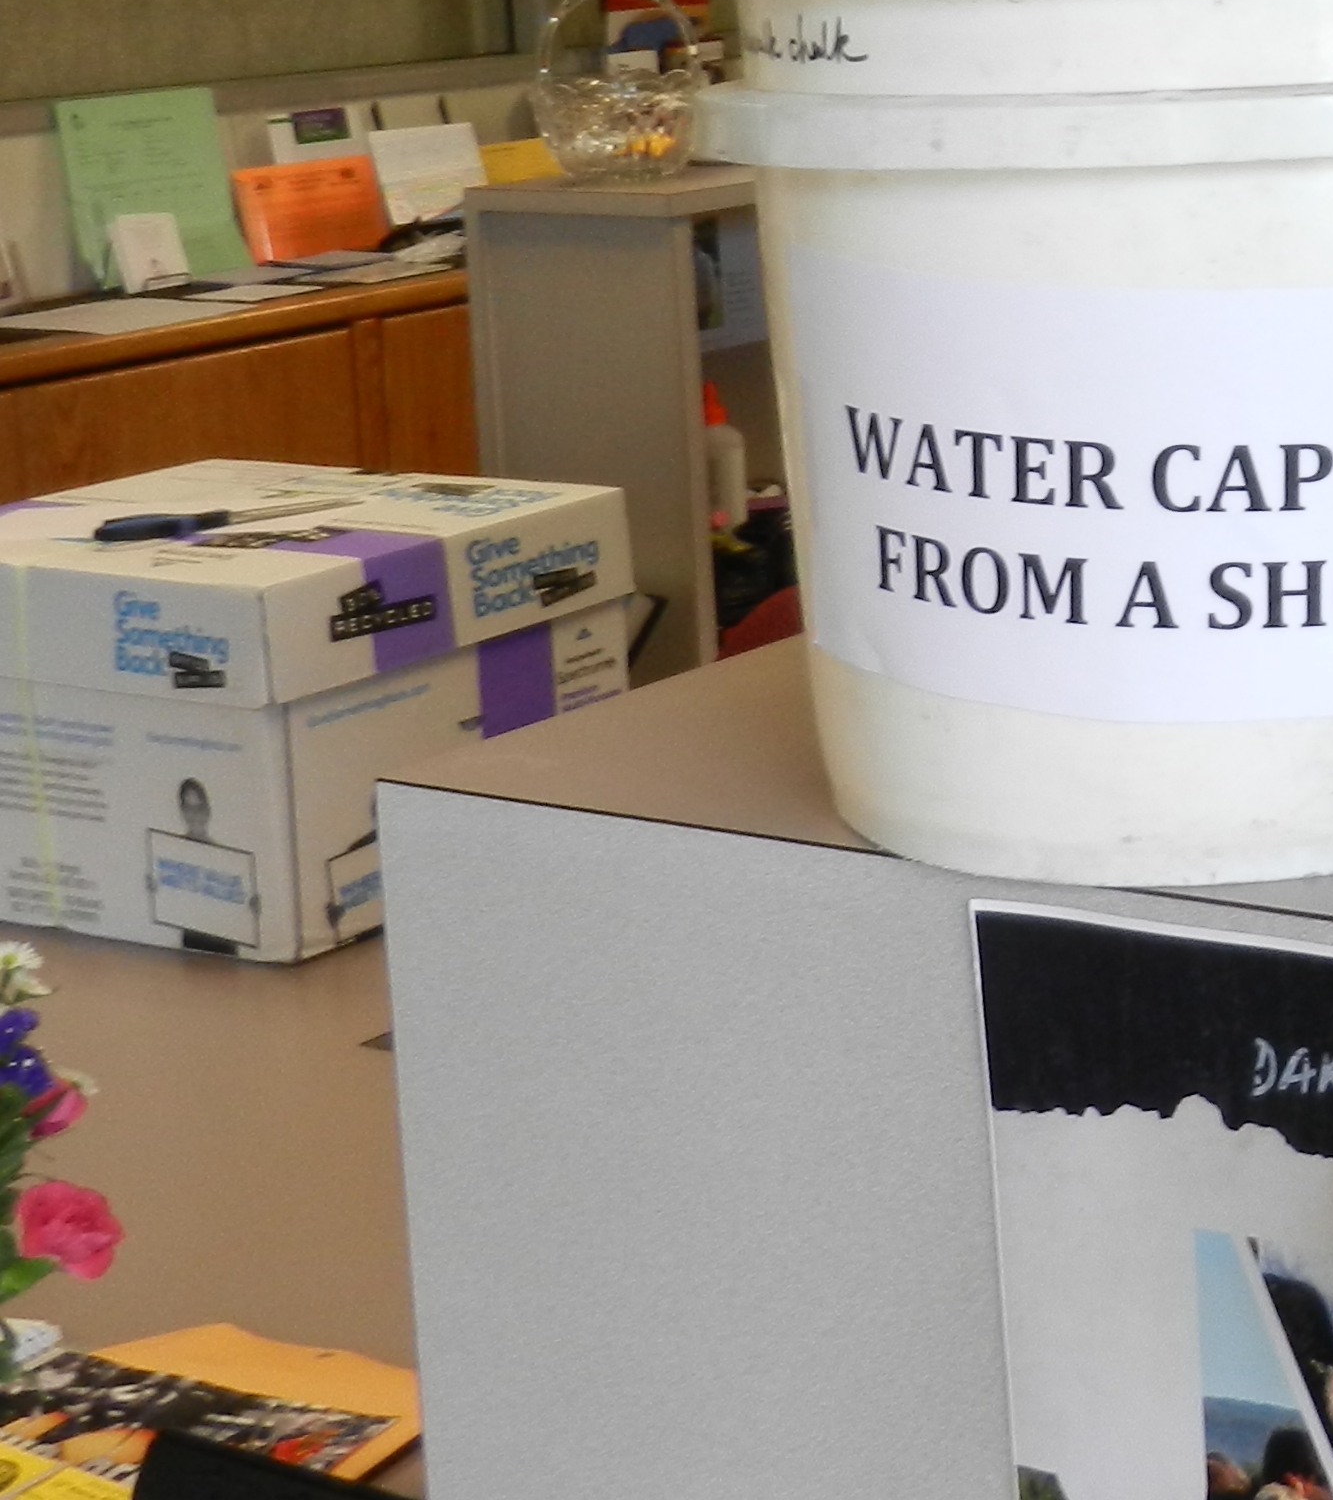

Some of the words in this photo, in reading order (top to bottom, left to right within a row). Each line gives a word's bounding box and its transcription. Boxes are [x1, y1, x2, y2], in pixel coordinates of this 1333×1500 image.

[788, 13, 869, 64] chalk
[845, 404, 1124, 511] WATER
[466, 536, 521, 567] Give
[470, 540, 600, 593] Something
[875, 525, 1088, 626] FROM
[1114, 561, 1179, 630] A
[333, 600, 433, 634] RECYCLED
